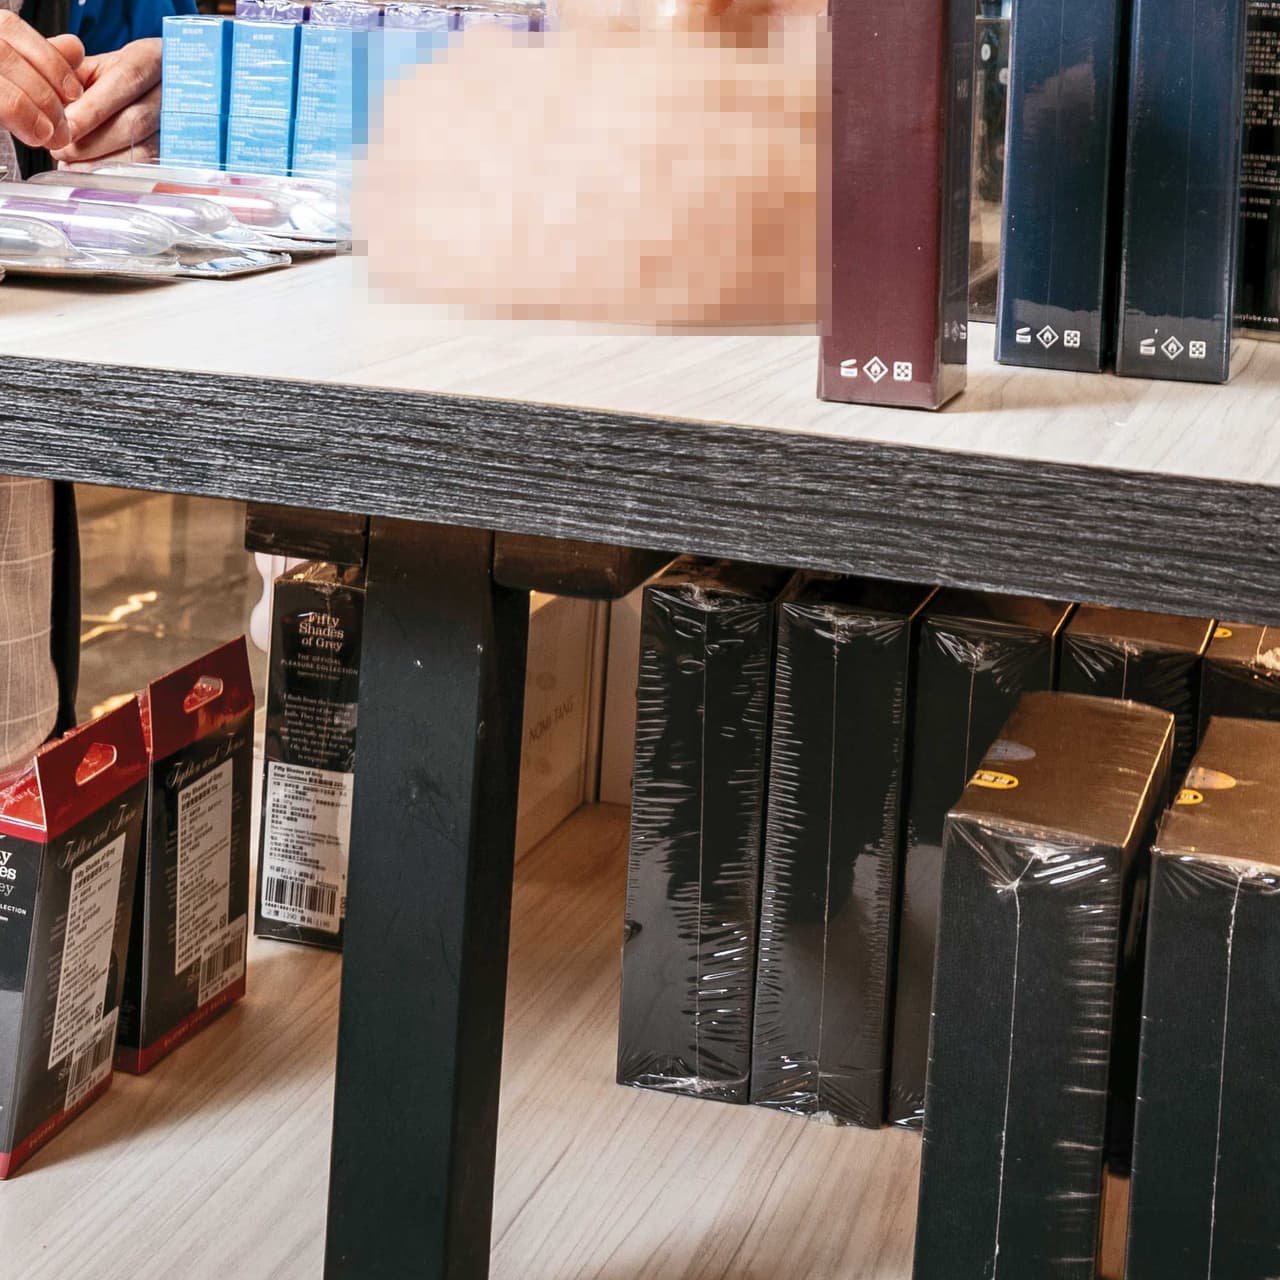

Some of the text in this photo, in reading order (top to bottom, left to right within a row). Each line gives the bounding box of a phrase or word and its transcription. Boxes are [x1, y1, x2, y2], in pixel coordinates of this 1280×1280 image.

[308, 612, 340, 628] Fifty
[298, 622, 344, 639] Shades
[301, 635, 343, 652] of Grey
